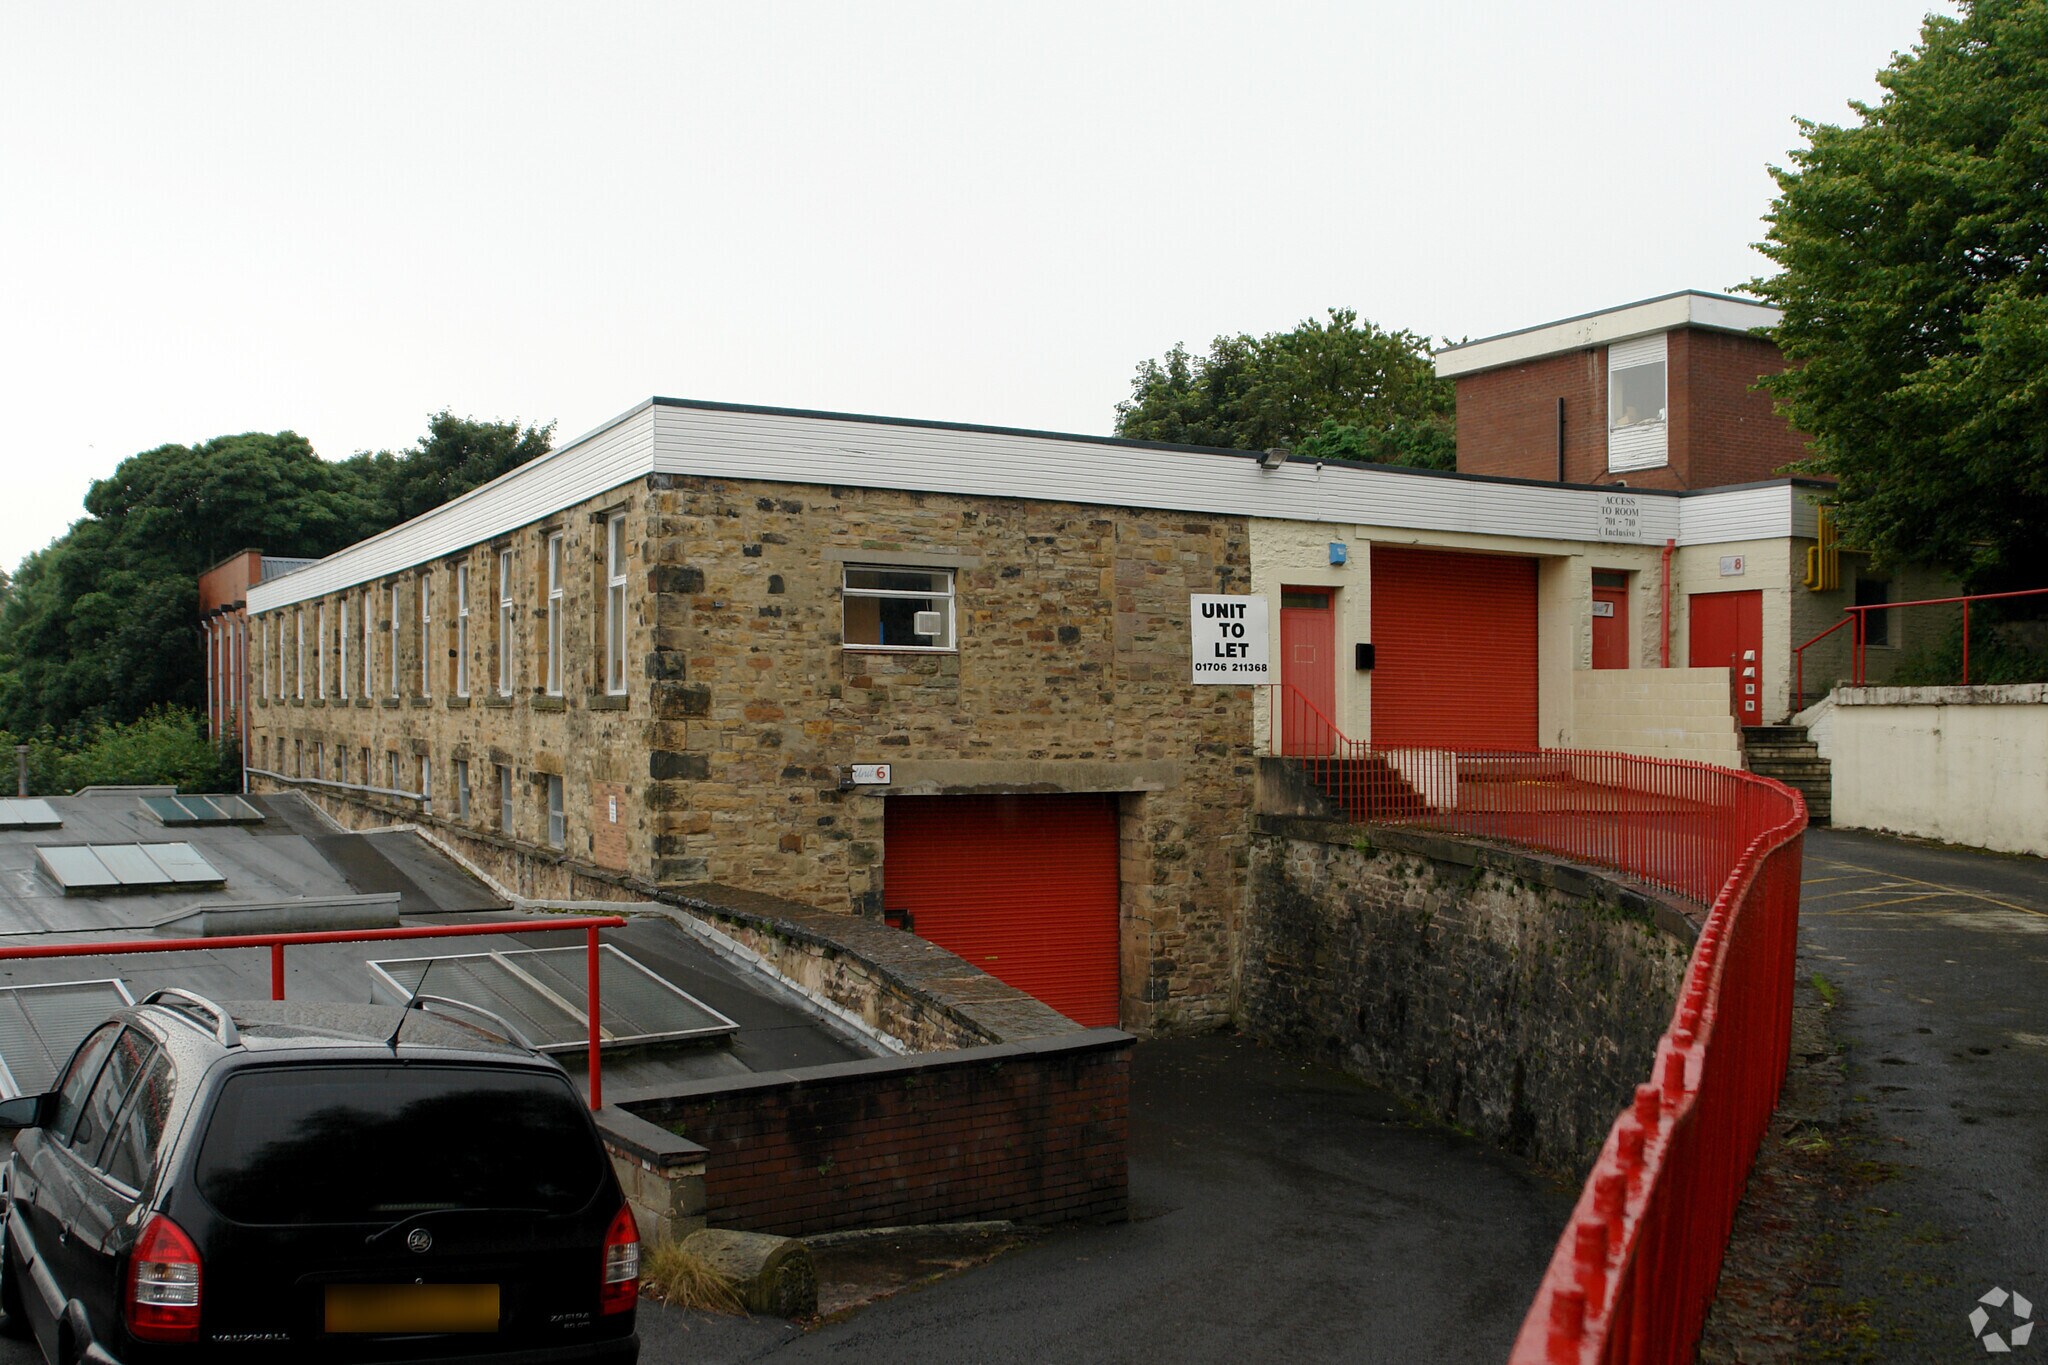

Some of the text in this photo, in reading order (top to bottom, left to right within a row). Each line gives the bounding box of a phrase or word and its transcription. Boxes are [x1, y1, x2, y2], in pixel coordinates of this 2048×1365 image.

[1605, 496, 1635, 506] ACCESS
[1601, 506, 1639, 517] TO ROOM
[1605, 517, 1616, 526] 701
[1625, 518, 1636, 527] 710
[1734, 558, 1742, 570] 8
[1201, 602, 1247, 619] UNIT
[1604, 603, 1610, 614] 7
[1218, 622, 1245, 638] TO
[1214, 642, 1249, 658] LET
[1195, 662, 1268, 672] 01706 211368
[877, 766, 885, 778] 6
